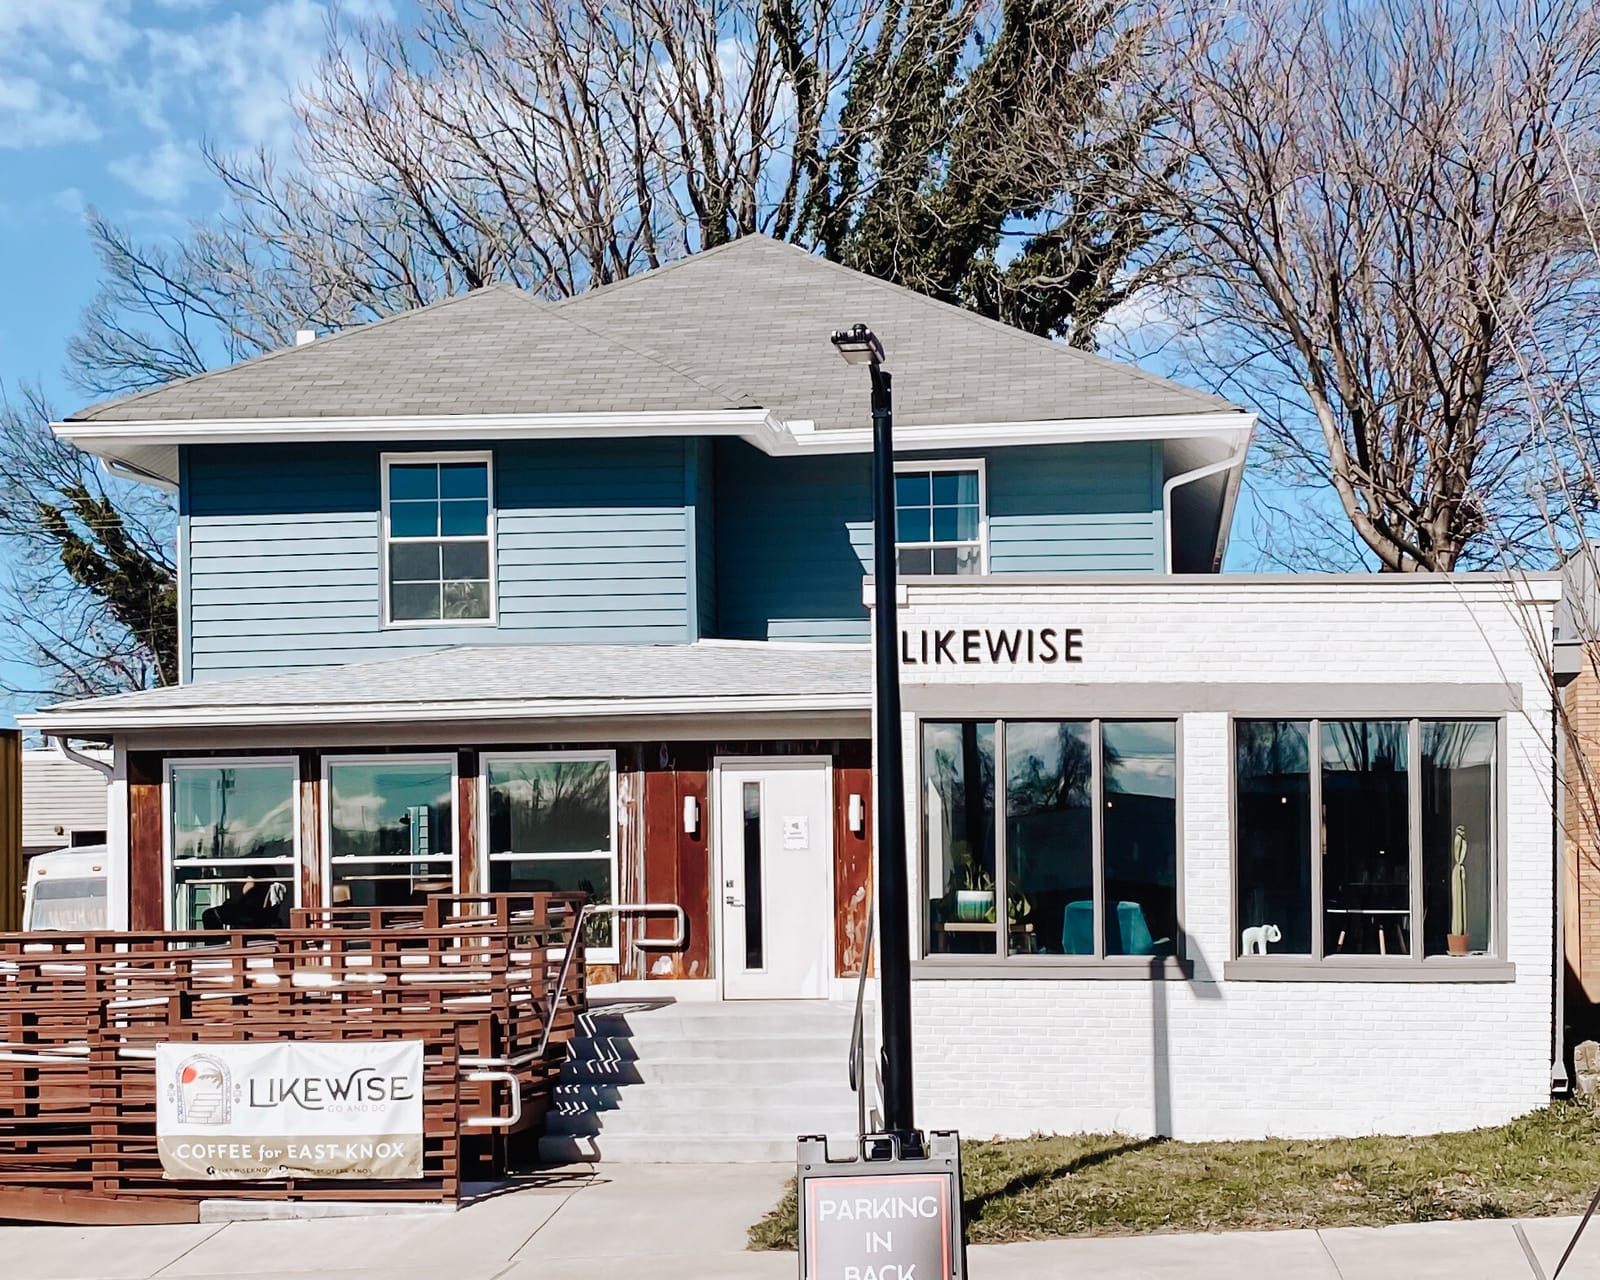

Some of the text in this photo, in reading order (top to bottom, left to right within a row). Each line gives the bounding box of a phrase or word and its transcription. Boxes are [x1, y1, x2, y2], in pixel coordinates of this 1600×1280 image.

[902, 628, 1083, 664] LIKEWISE
[249, 1068, 414, 1110] LIKEWISE
[328, 1104, 343, 1113] GO
[347, 1104, 368, 1113] AND
[176, 1142, 405, 1162] COFFEE for EAST KNOX
[819, 1196, 938, 1221] PARKING
[865, 1231, 893, 1253] IN
[844, 1264, 916, 1280] BACK
